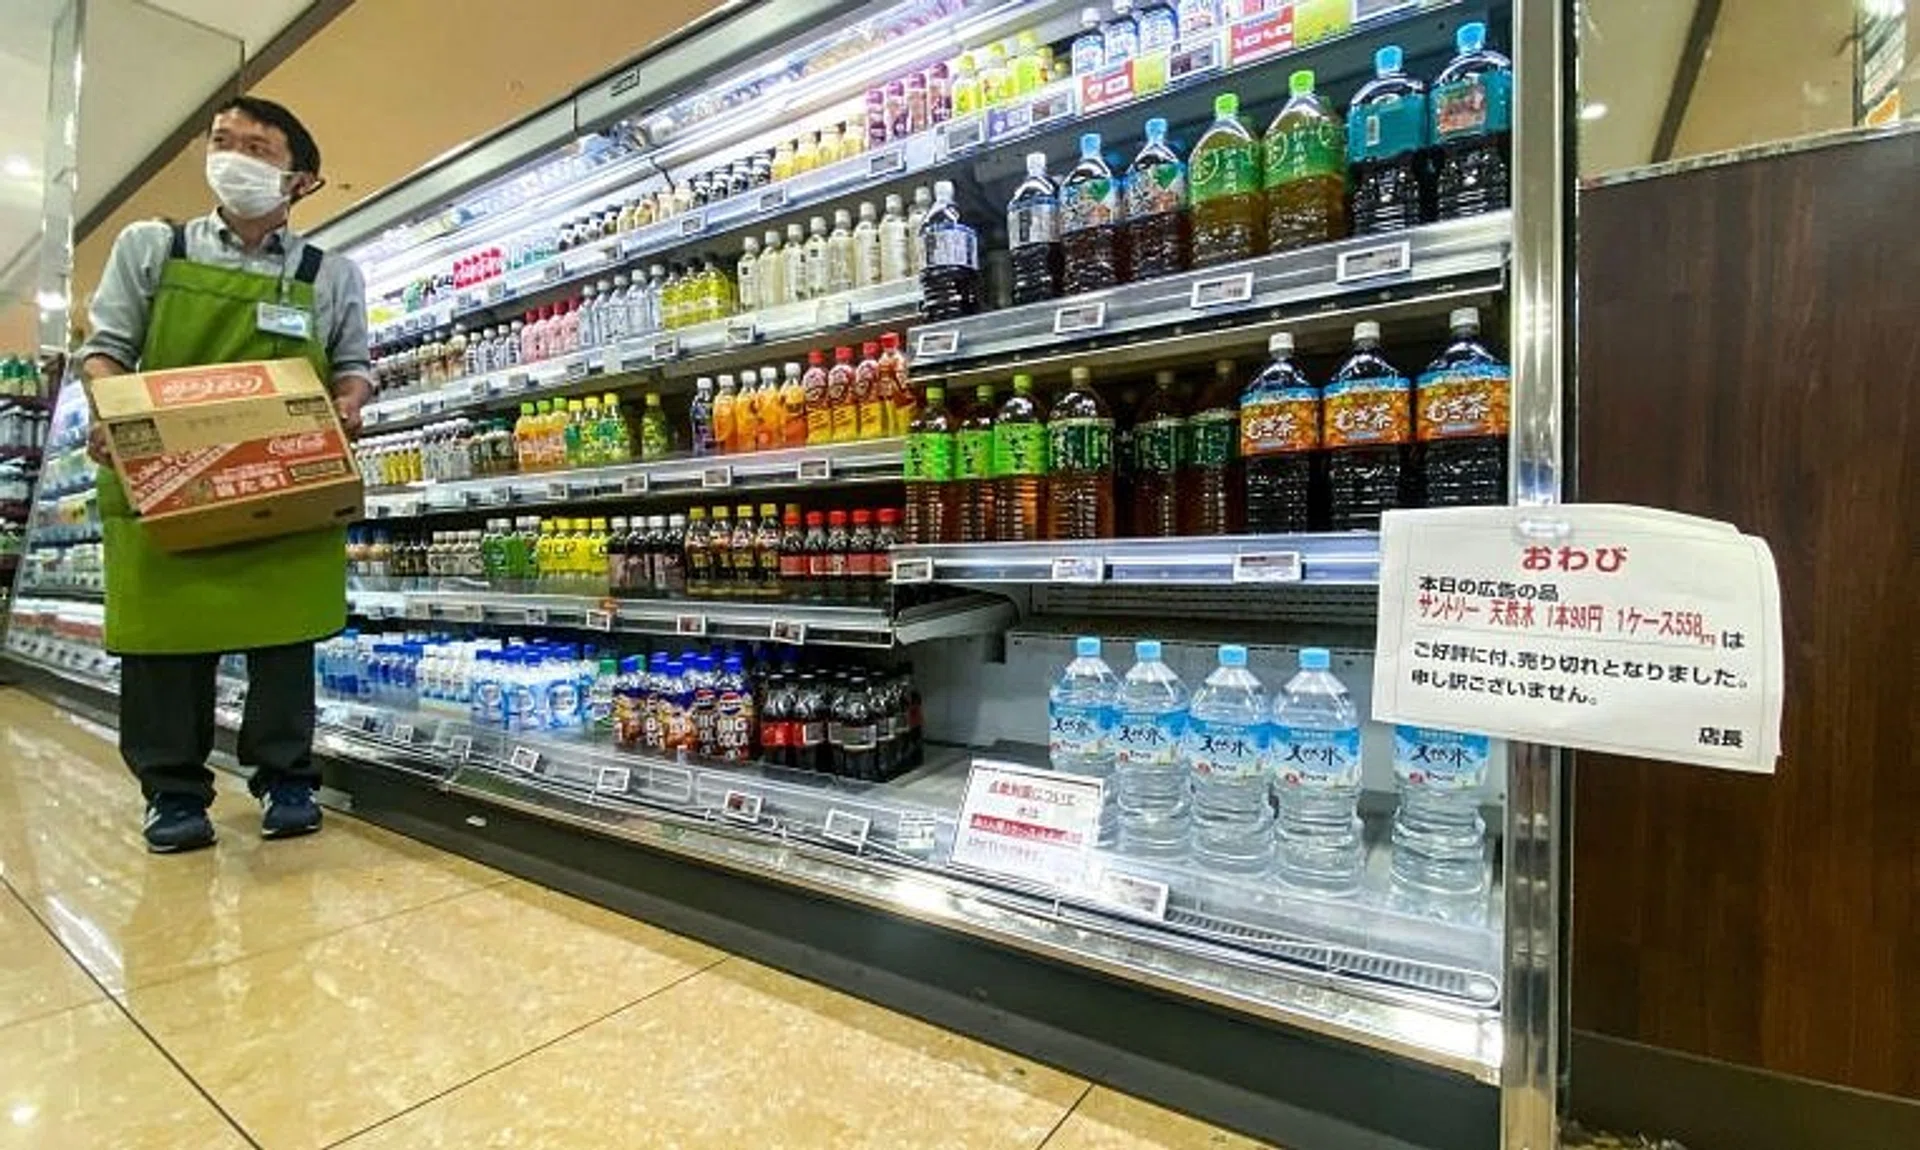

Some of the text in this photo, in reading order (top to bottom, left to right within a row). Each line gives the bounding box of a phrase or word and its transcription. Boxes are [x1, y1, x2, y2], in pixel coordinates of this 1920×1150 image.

[1335, 402, 1393, 430] むぎ茶
[1427, 393, 1489, 421] むぎ茶
[1247, 412, 1295, 440] むぎ茶
[1522, 546, 1629, 573] おわび
[1418, 576, 1559, 602] 本日の広告の品
[1419, 594, 1480, 622] サントリー
[1488, 599, 1535, 628] 天然水
[1411, 669, 1598, 706] 申し訳ございません。
[1120, 725, 1166, 745] 天然水
[1200, 735, 1252, 757] 天然水
[1699, 726, 1744, 748] 店長
[1286, 743, 1345, 766] 天然水
[1410, 745, 1474, 768] 天然水
